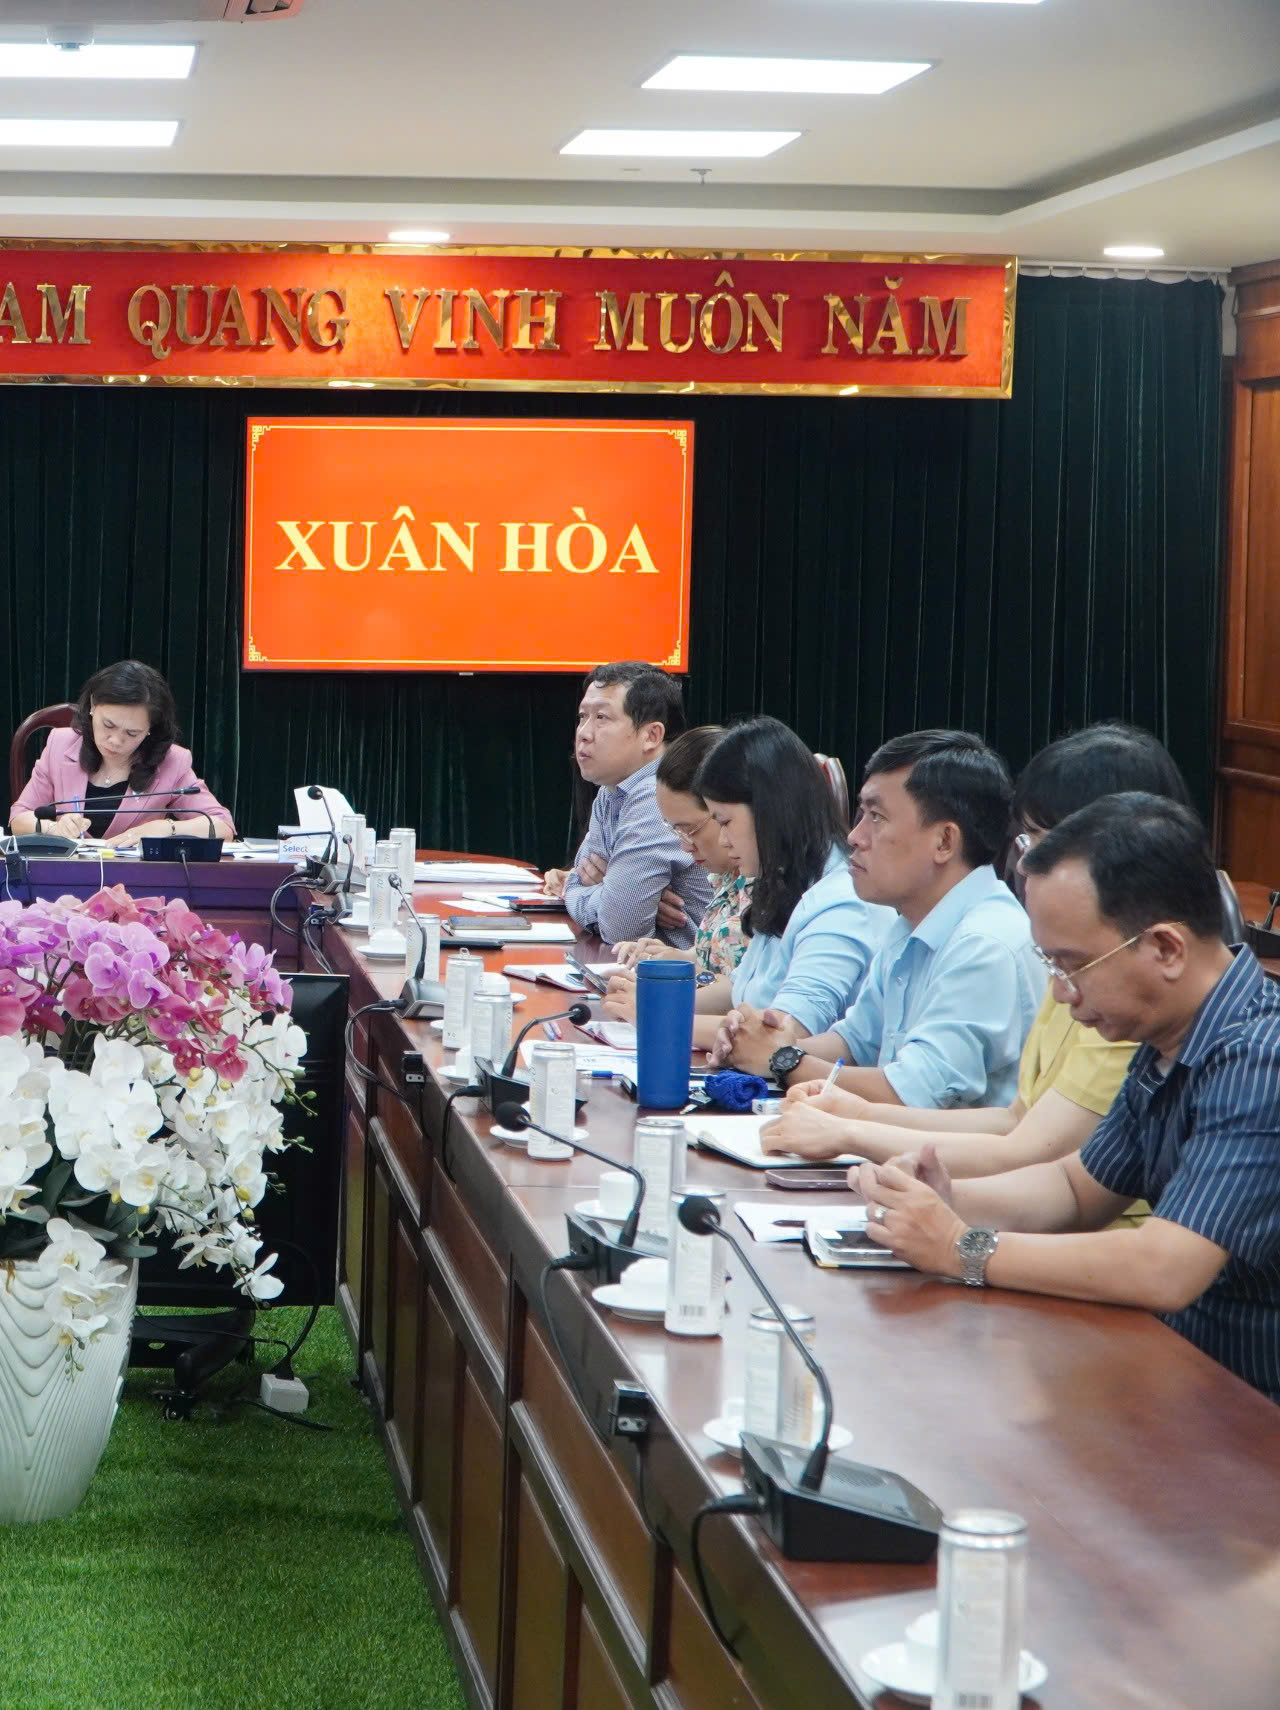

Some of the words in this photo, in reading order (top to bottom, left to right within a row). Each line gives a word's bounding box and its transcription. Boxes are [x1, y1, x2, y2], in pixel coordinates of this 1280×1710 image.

[127, 284, 350, 360] QUANG
[384, 288, 560, 351] VINH
[594, 271, 788, 355] MUÔN
[822, 276, 972, 356] NĂM
[274, 505, 480, 572] XUÂN
[499, 507, 660, 573] HÒA
[282, 844, 308, 853] Select
